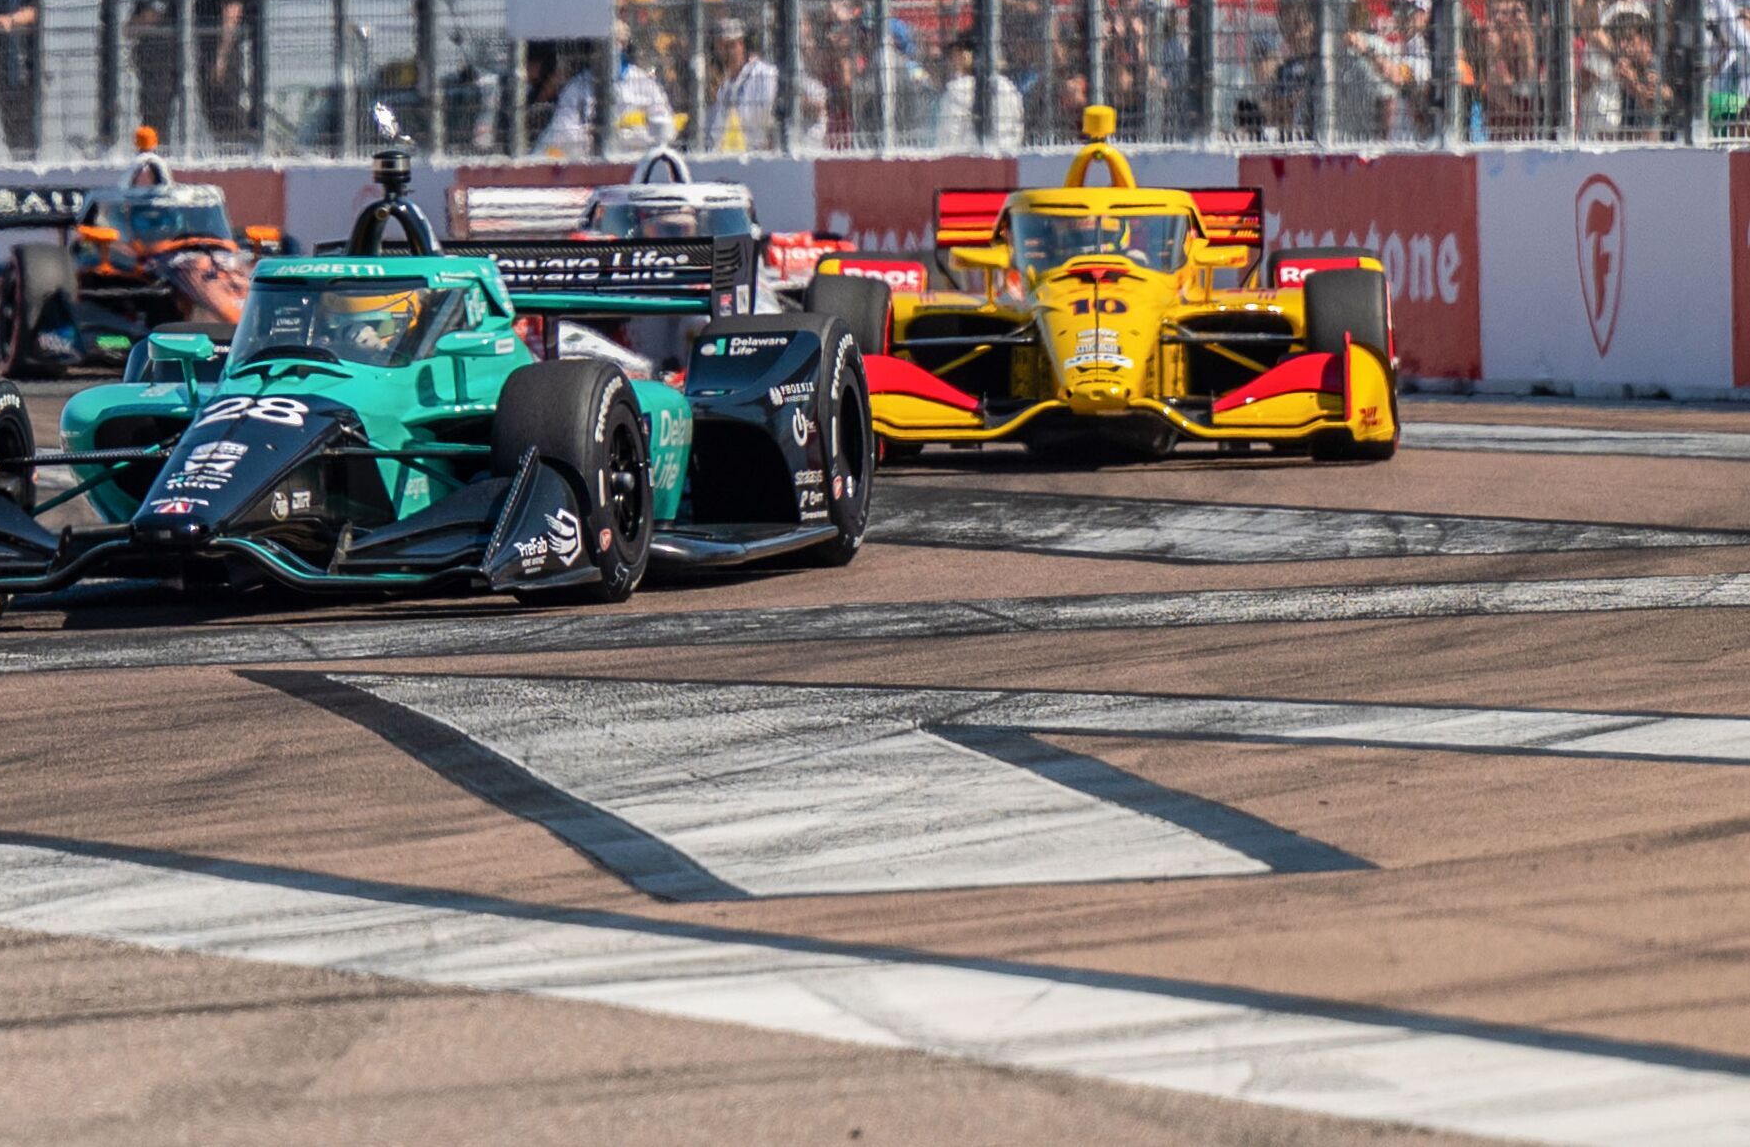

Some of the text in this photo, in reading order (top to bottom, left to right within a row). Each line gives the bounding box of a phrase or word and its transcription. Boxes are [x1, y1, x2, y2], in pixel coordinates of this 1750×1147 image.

[273, 263, 386, 276] ANDRETTI
[730, 336, 788, 347] Delaware
[194, 397, 310, 429] 28
[514, 537, 548, 557] PreFab
